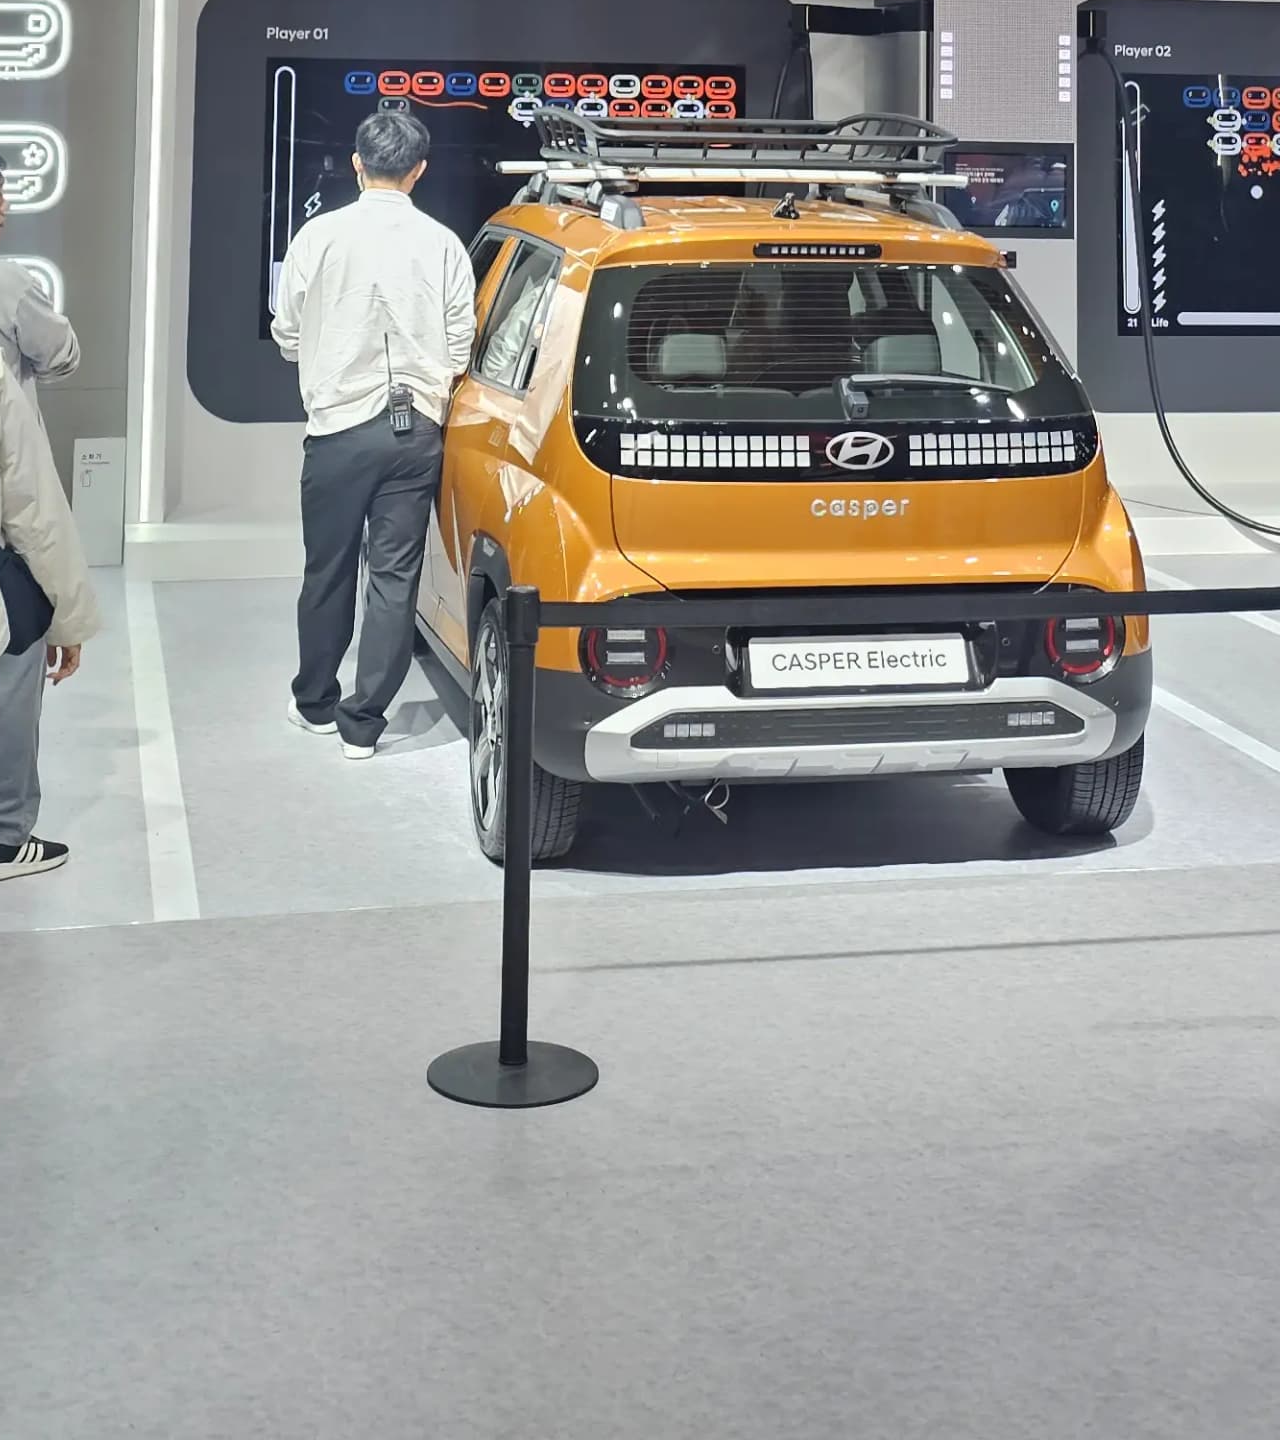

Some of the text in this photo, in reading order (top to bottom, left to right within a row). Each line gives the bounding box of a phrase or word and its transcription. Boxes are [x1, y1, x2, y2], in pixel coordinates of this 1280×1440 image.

[266, 26, 329, 42] Player 01
[1114, 44, 1172, 59] Player 02
[810, 498, 910, 520] casper
[771, 648, 947, 672] CASPER Electric
